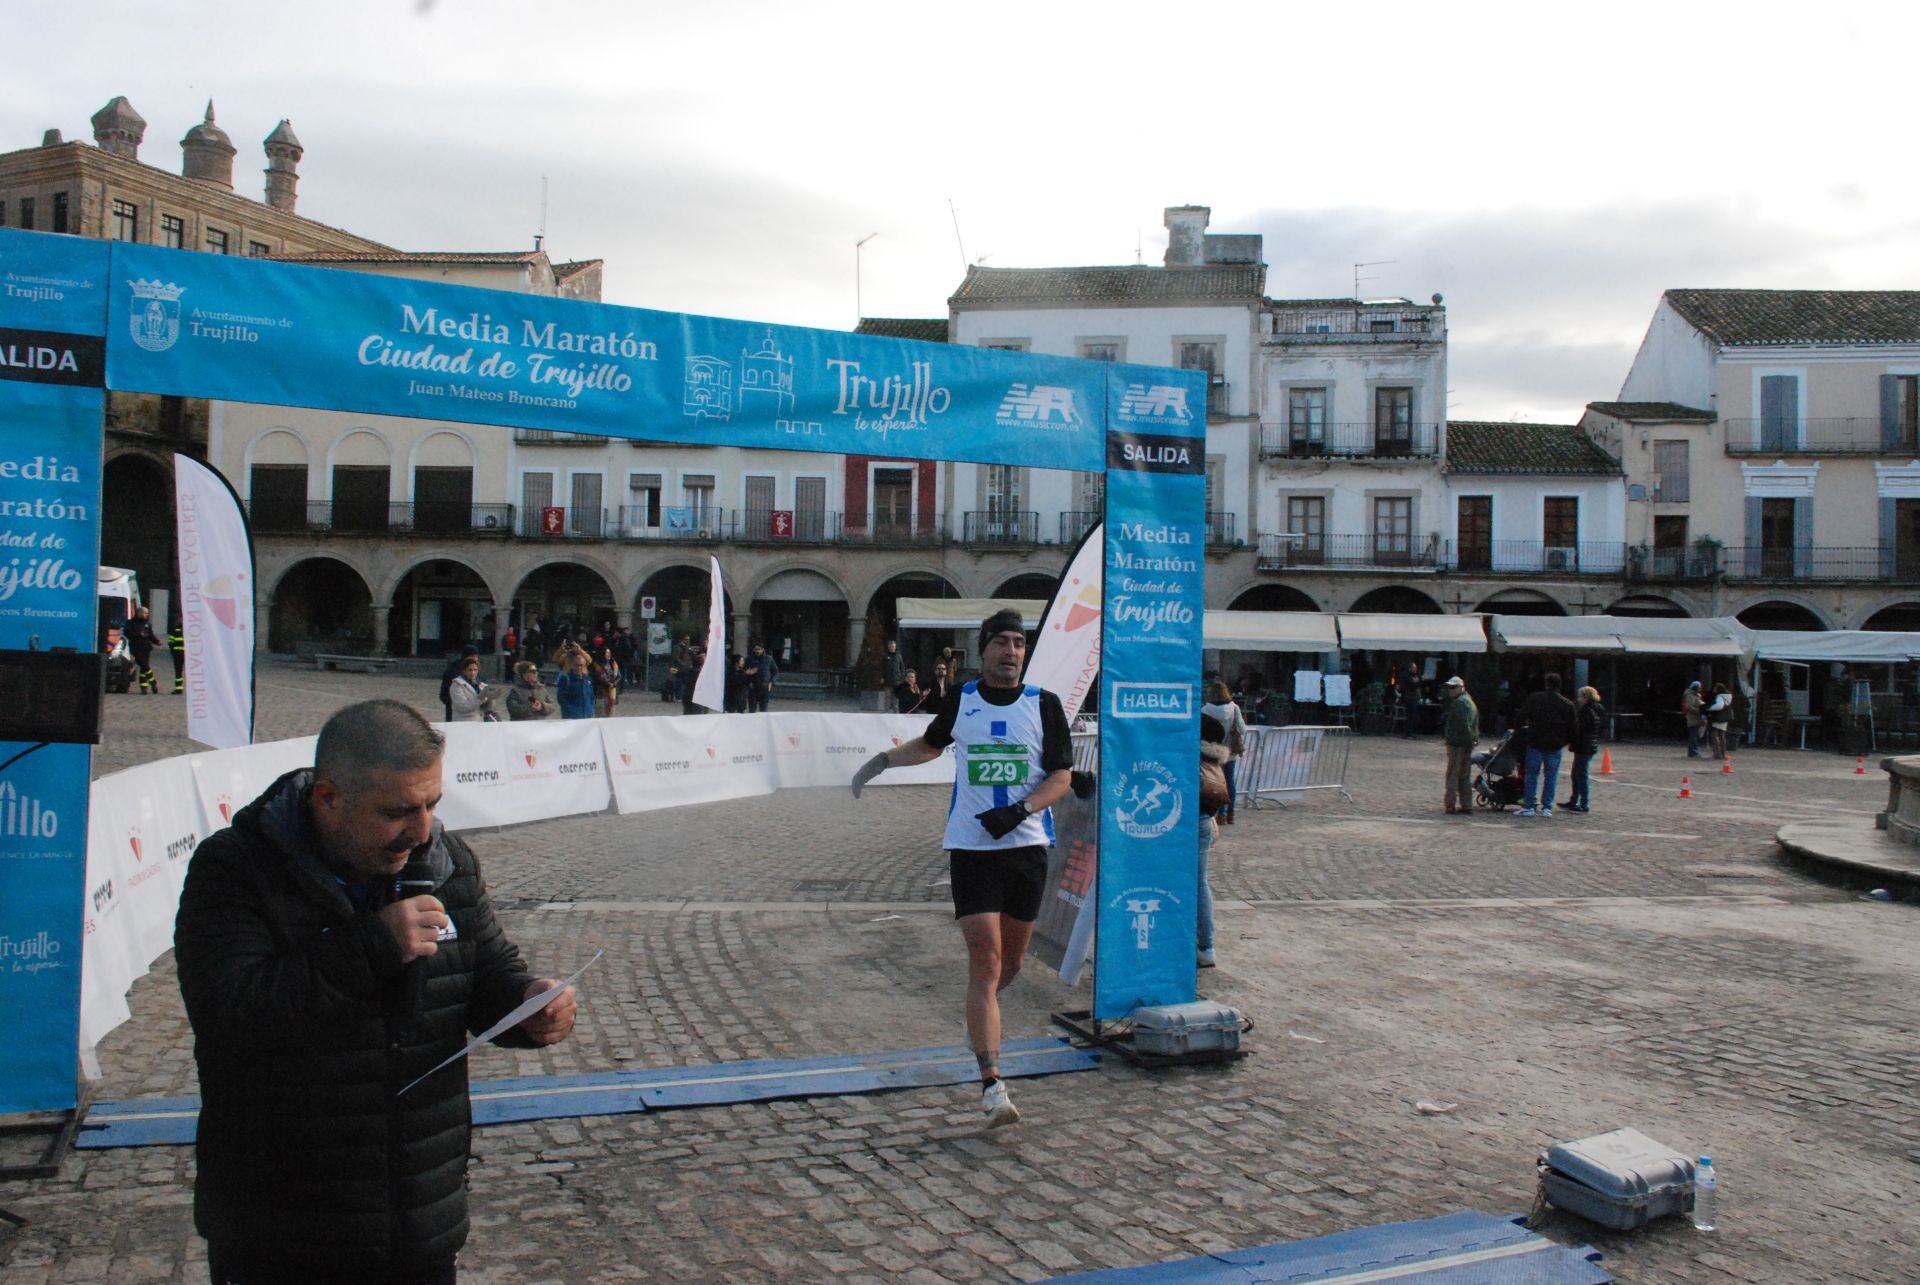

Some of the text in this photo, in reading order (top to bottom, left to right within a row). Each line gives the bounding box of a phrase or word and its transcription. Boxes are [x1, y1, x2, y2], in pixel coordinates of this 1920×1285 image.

[7, 272, 94, 289] Ayuntamiento de
[4, 284, 64, 302] Trujillo
[192, 307, 294, 328] Ayuntamiento de
[190, 321, 258, 343] Trujillo
[400, 304, 659, 361] Media Maratón
[357, 334, 632, 398] Ciudad de Trujillo
[408, 379, 577, 409] Juan Mateos Broncano
[826, 358, 951, 424] Trujillo
[855, 411, 869, 431] te
[996, 418, 1079, 432] www.musicrun.es
[1118, 414, 1189, 426] www.musicrun.es
[1123, 443, 1190, 464] SALIDA
[0, 455, 81, 483] edia
[0, 497, 88, 521] ratón
[0, 530, 68, 550] dad de
[1119, 522, 1192, 545] Media
[1114, 552, 1197, 573] Maratón
[1123, 578, 1184, 594] Ciudad de
[1, 607, 79, 619] eos Broncano
[1112, 594, 1194, 632] Trujillo
[1123, 692, 1181, 709] HABLA
[978, 761, 1017, 782] 229
[1112, 760, 1177, 797] Club Atletismo
